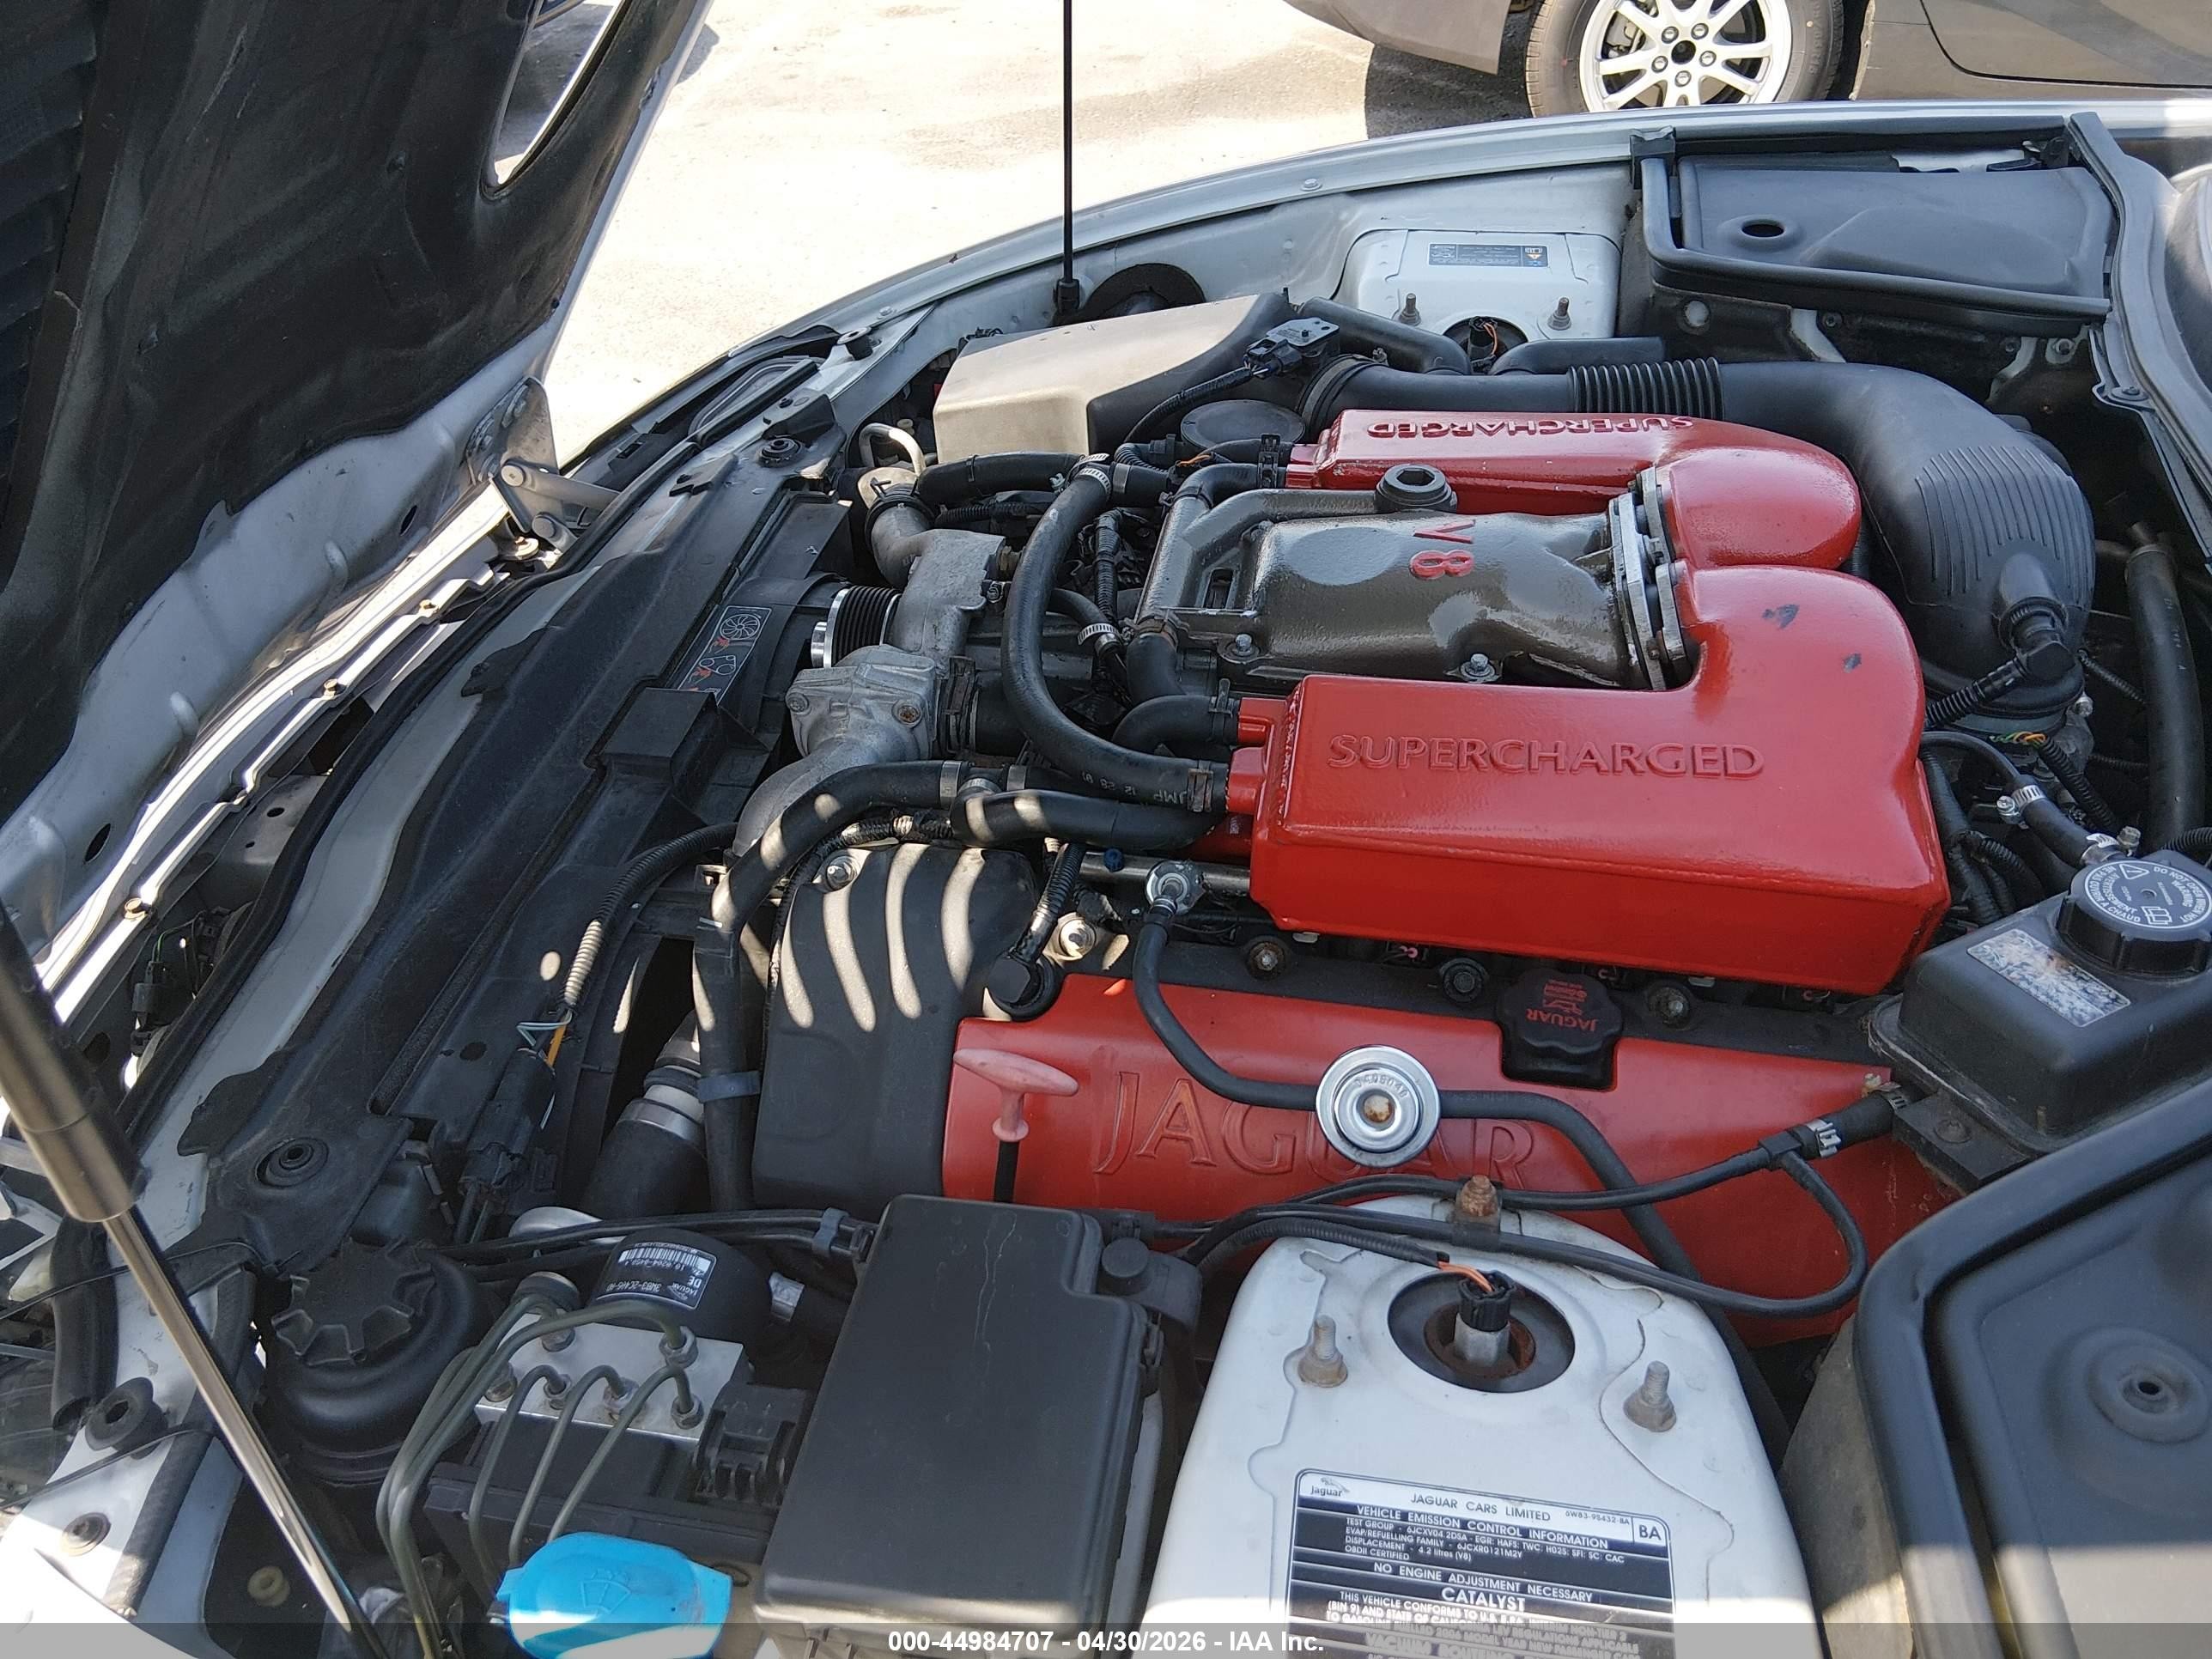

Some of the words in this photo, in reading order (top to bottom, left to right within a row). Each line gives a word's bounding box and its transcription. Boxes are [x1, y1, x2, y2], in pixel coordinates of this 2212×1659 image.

[1368, 416, 1694, 439] SUPERCHARGED
[1409, 519, 1477, 580] V8
[1327, 734, 1765, 781] SUPERCHARGED
[2169, 872, 2191, 882] NOT
[2171, 880, 2193, 908] WARNING
[2186, 882, 2205, 897] OPEN
[2107, 906, 2141, 922] CHAUD
[2179, 912, 2199, 923] HOT
[1525, 1008, 1599, 1031] JAGUAR
[672, 1281, 698, 1296] JAGUAR
[688, 1275, 702, 1288] DE
[1411, 1493, 1458, 1509] JAGUAR
[1466, 1502, 1498, 1515] CARS
[1505, 1507, 1551, 1521] LIMITED
[1346, 1528, 1413, 1542] EVAP/REFUELLING
[1417, 1535, 1444, 1547] FAMILY
[1357, 1505, 1401, 1520] VEHICLE
[1407, 1512, 1461, 1528] EMISSION
[1467, 1520, 1522, 1537] CONTROL
[1529, 1528, 1608, 1549] INFORMATION
[1639, 1524, 1662, 1540] BA
[1345, 1536, 1405, 1551] DISPLACEMENT
[1418, 1546, 1431, 1554] 4.2
[1433, 1548, 1454, 1559] litres
[1455, 1551, 1472, 1562] (V8)
[1346, 1517, 1364, 1527] TEST
[1364, 1519, 1395, 1530] GROUP
[1605, 1554, 1625, 1564] CAC
[1370, 1549, 1409, 1561] CERTIFIED
[1374, 1562, 1392, 1574] NO
[1399, 1565, 1442, 1581] ENGINE
[1448, 1574, 1521, 1592] ADJUSTMENT
[1528, 1585, 1593, 1602] NECESSARY
[1328, 1600, 1347, 1612] (BIN
[1350, 1603, 1360, 1615] 9)
[1361, 1605, 1384, 1618] AND
[1386, 1608, 1413, 1622] STATE
[1340, 1591, 1359, 1602] THIS
[1363, 1594, 1401, 1608] VEHICLE
[1403, 1601, 1462, 1619] CONFORMS
[1463, 1609, 1477, 1620] TO
[1442, 1587, 1526, 1612] CATALYST
[1326, 1610, 1340, 1623] TO
